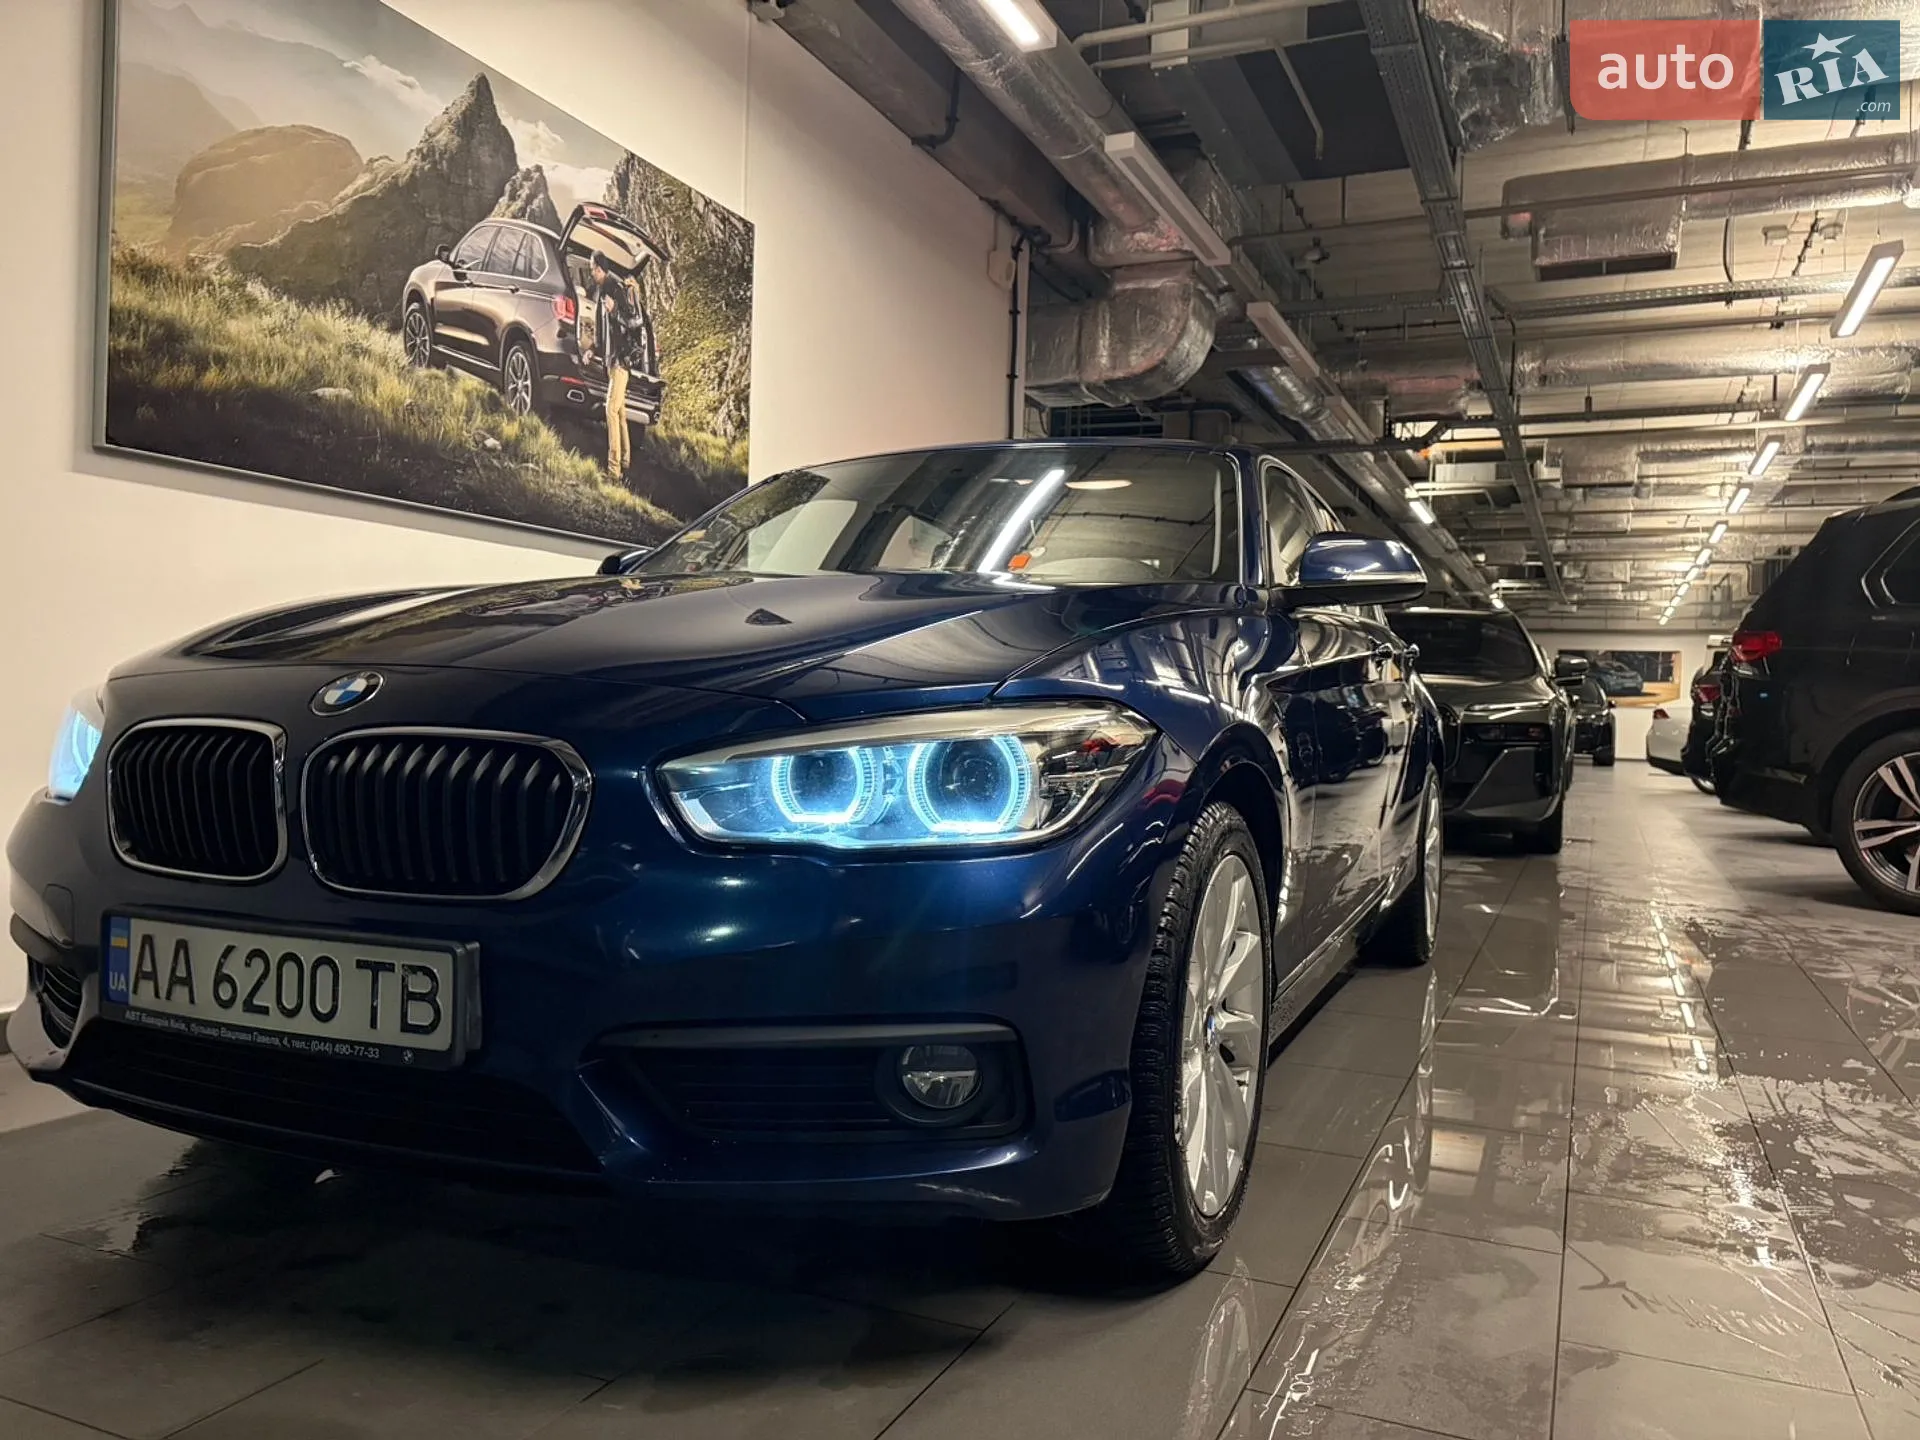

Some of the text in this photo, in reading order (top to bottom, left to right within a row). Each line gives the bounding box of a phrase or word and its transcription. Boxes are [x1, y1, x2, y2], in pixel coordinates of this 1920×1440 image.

[109, 971, 127, 992] UA
[132, 934, 442, 1036] AA 6200 TB
[311, 1040, 333, 1054] (044)
[334, 1044, 380, 1058] 490-77-33
